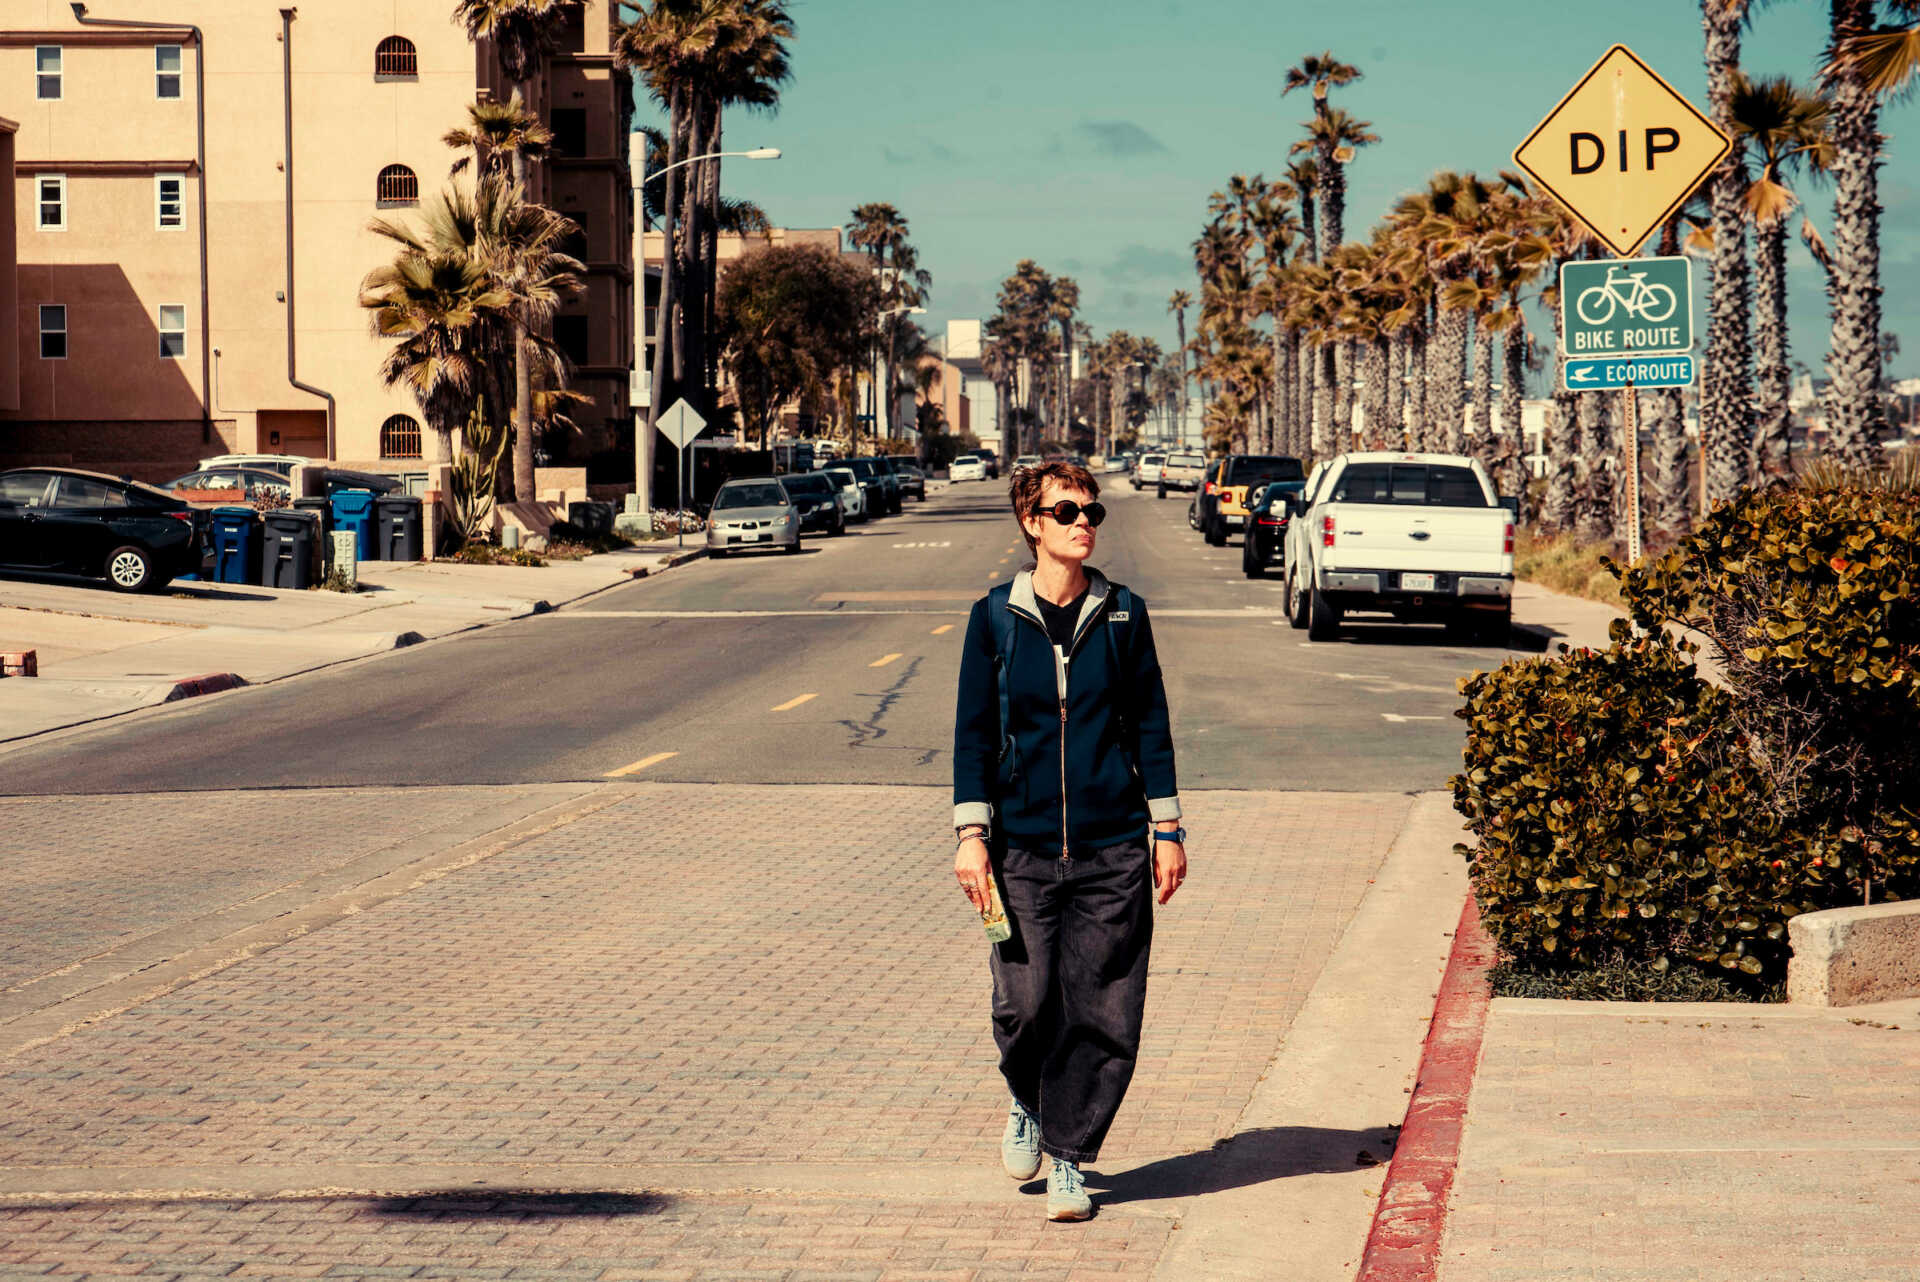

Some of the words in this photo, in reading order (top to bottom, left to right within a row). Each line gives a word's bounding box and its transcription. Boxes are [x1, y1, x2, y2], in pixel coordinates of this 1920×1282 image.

[1569, 127, 1681, 176] DIP
[1574, 330, 1616, 350] BIKE
[1623, 326, 1681, 347] ROUTE
[1606, 362, 1690, 383] ECOROUTE
